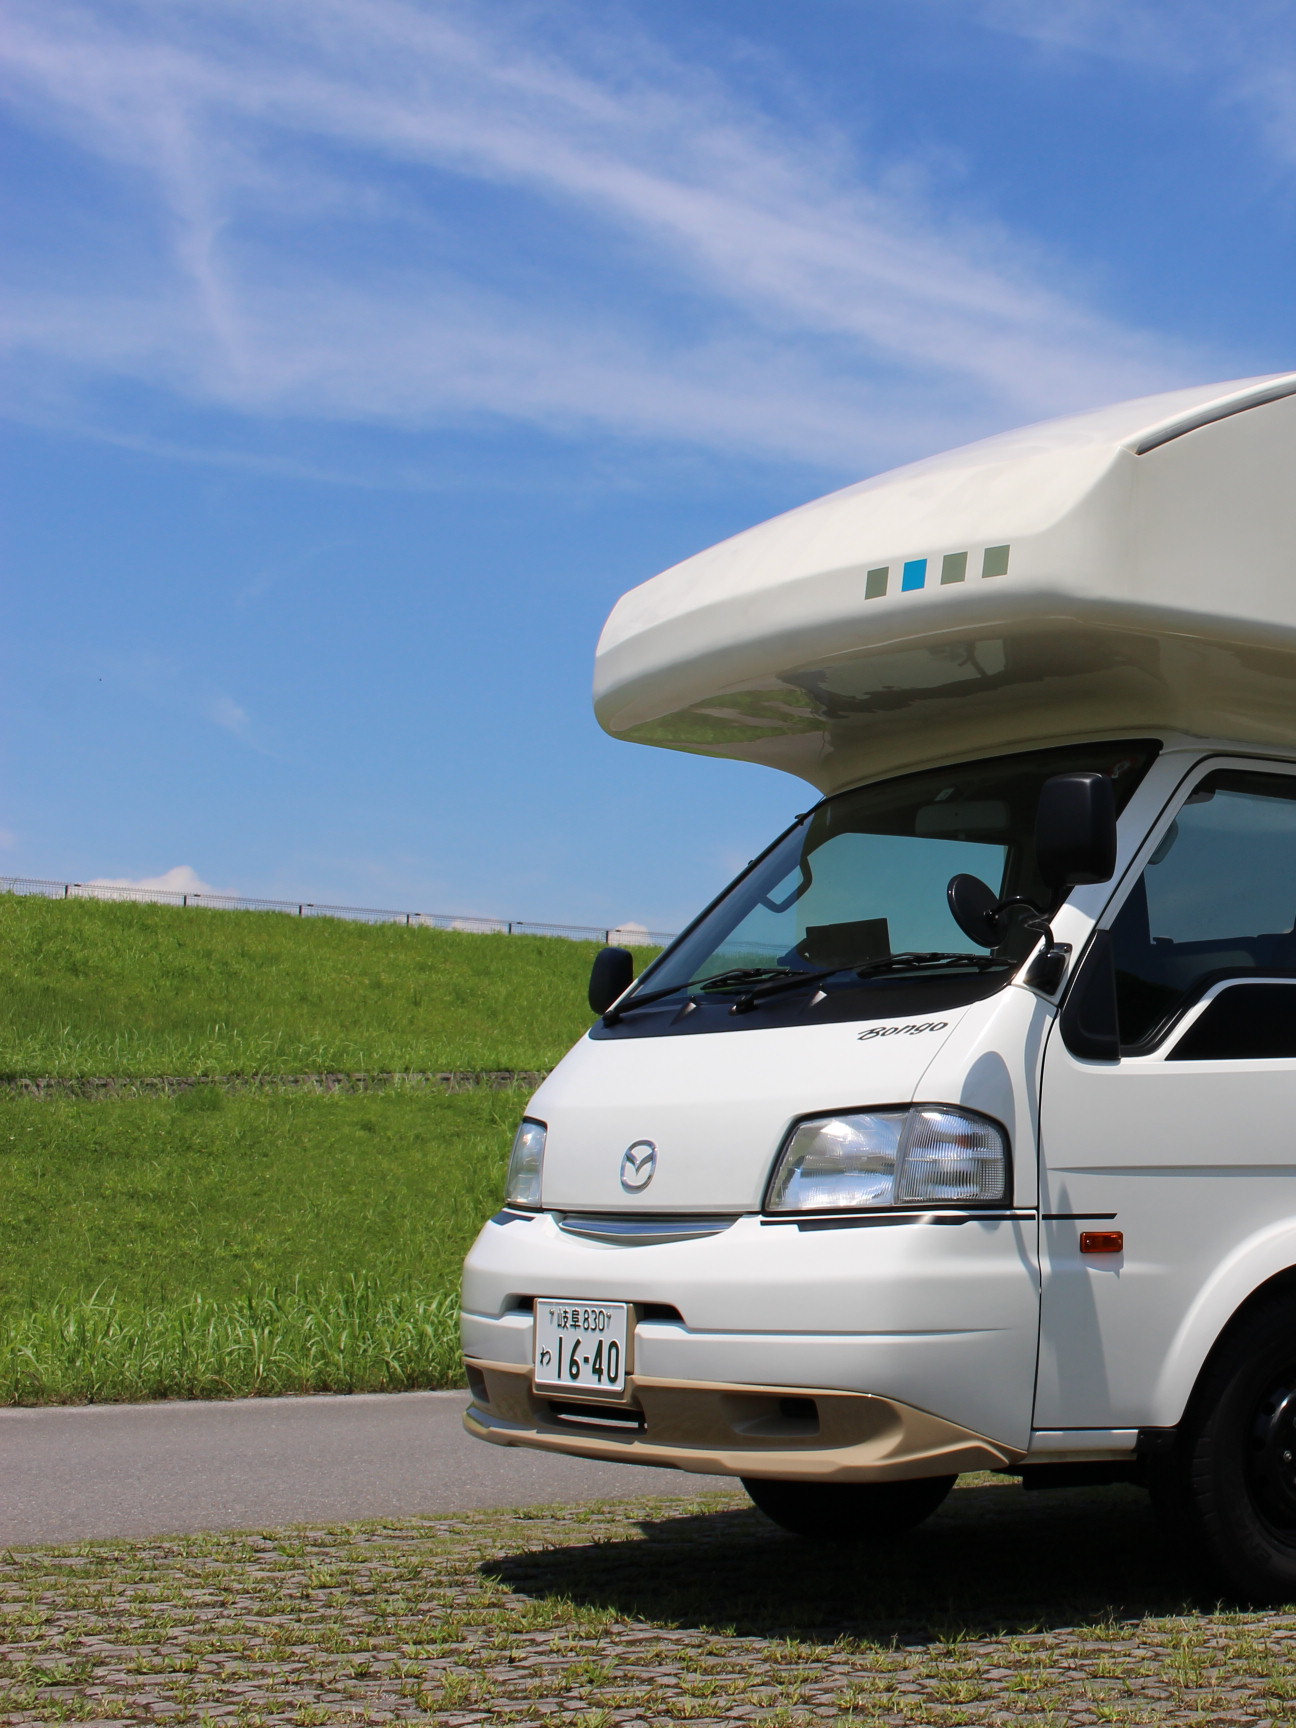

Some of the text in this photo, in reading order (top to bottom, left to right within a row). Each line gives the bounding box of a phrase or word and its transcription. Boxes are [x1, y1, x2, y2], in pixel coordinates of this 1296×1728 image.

[857, 1021, 949, 1041] Bongo
[540, 1335, 620, 1384] わ 16-40
